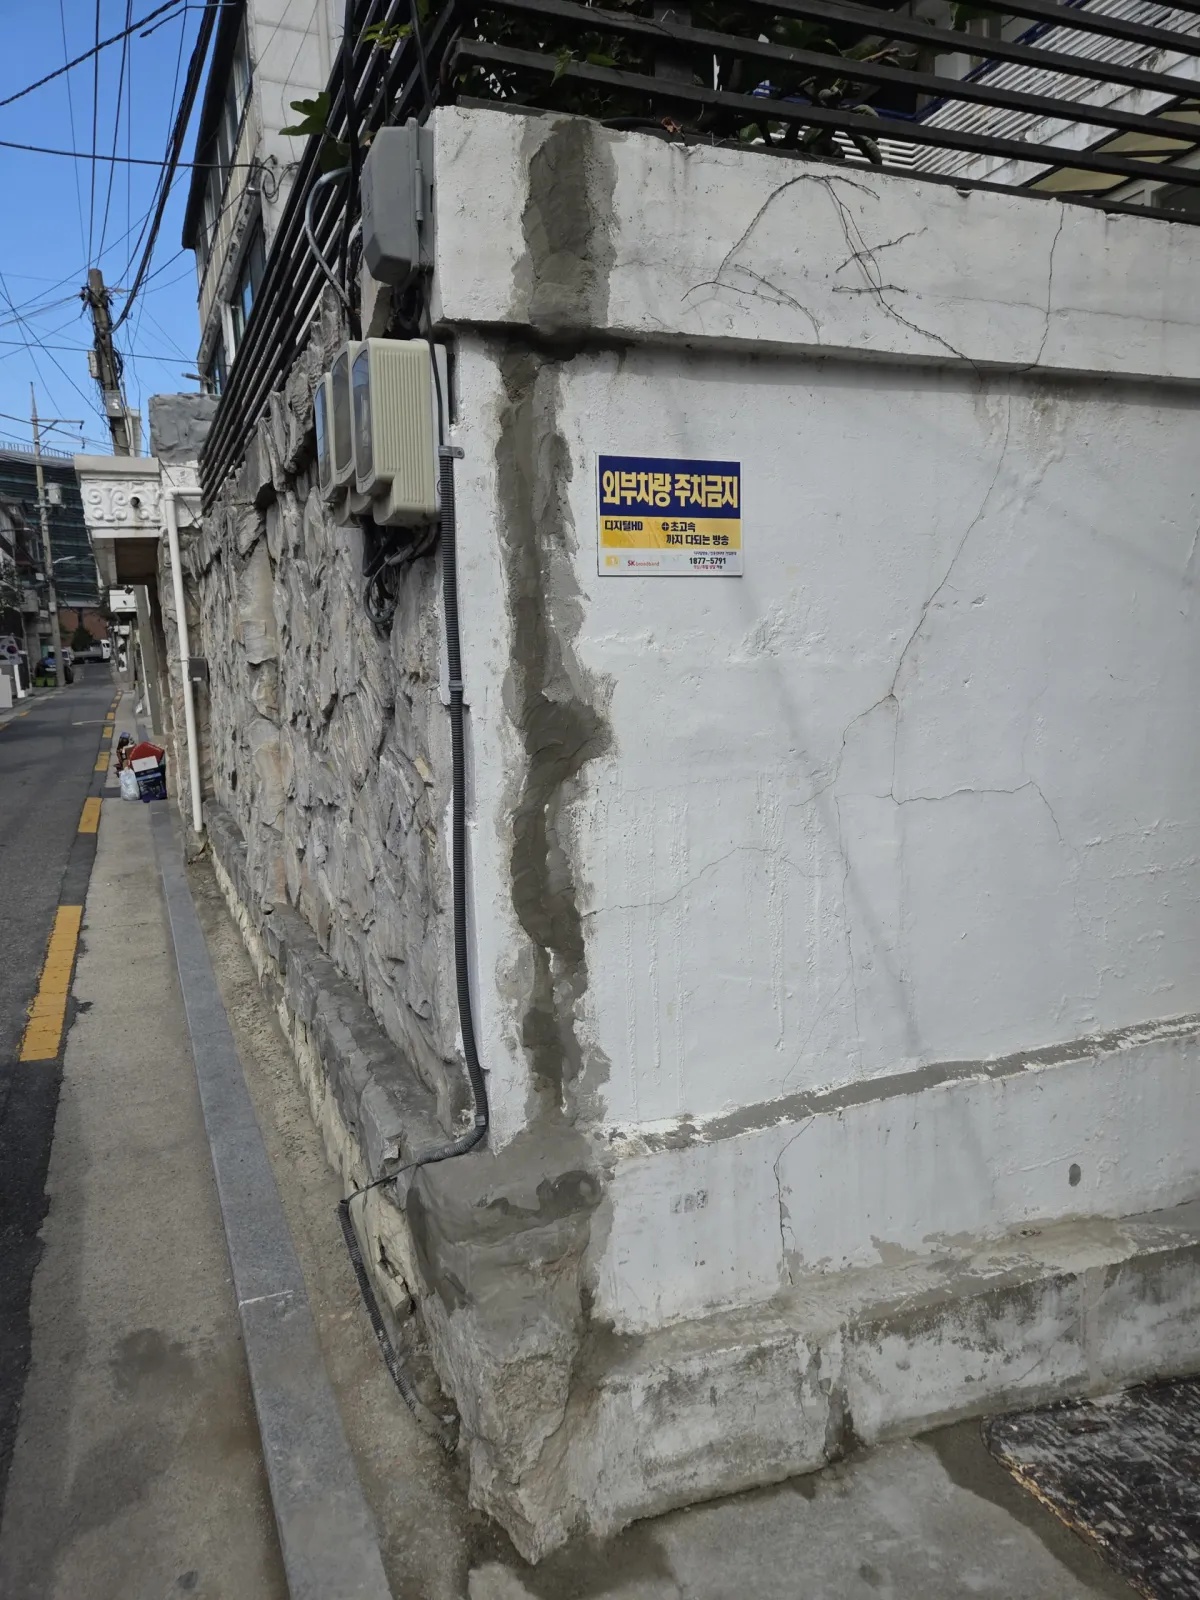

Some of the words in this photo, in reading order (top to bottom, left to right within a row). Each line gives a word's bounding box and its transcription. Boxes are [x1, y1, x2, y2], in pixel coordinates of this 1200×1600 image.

[602, 470, 671, 507] 외부차량
[674, 473, 738, 508] 주차금지
[670, 521, 696, 532] 초고속
[666, 534, 683, 545] 까지
[685, 534, 711, 546] 다되는
[712, 535, 729, 546] 방송
[689, 557, 726, 565] 1877-5791
